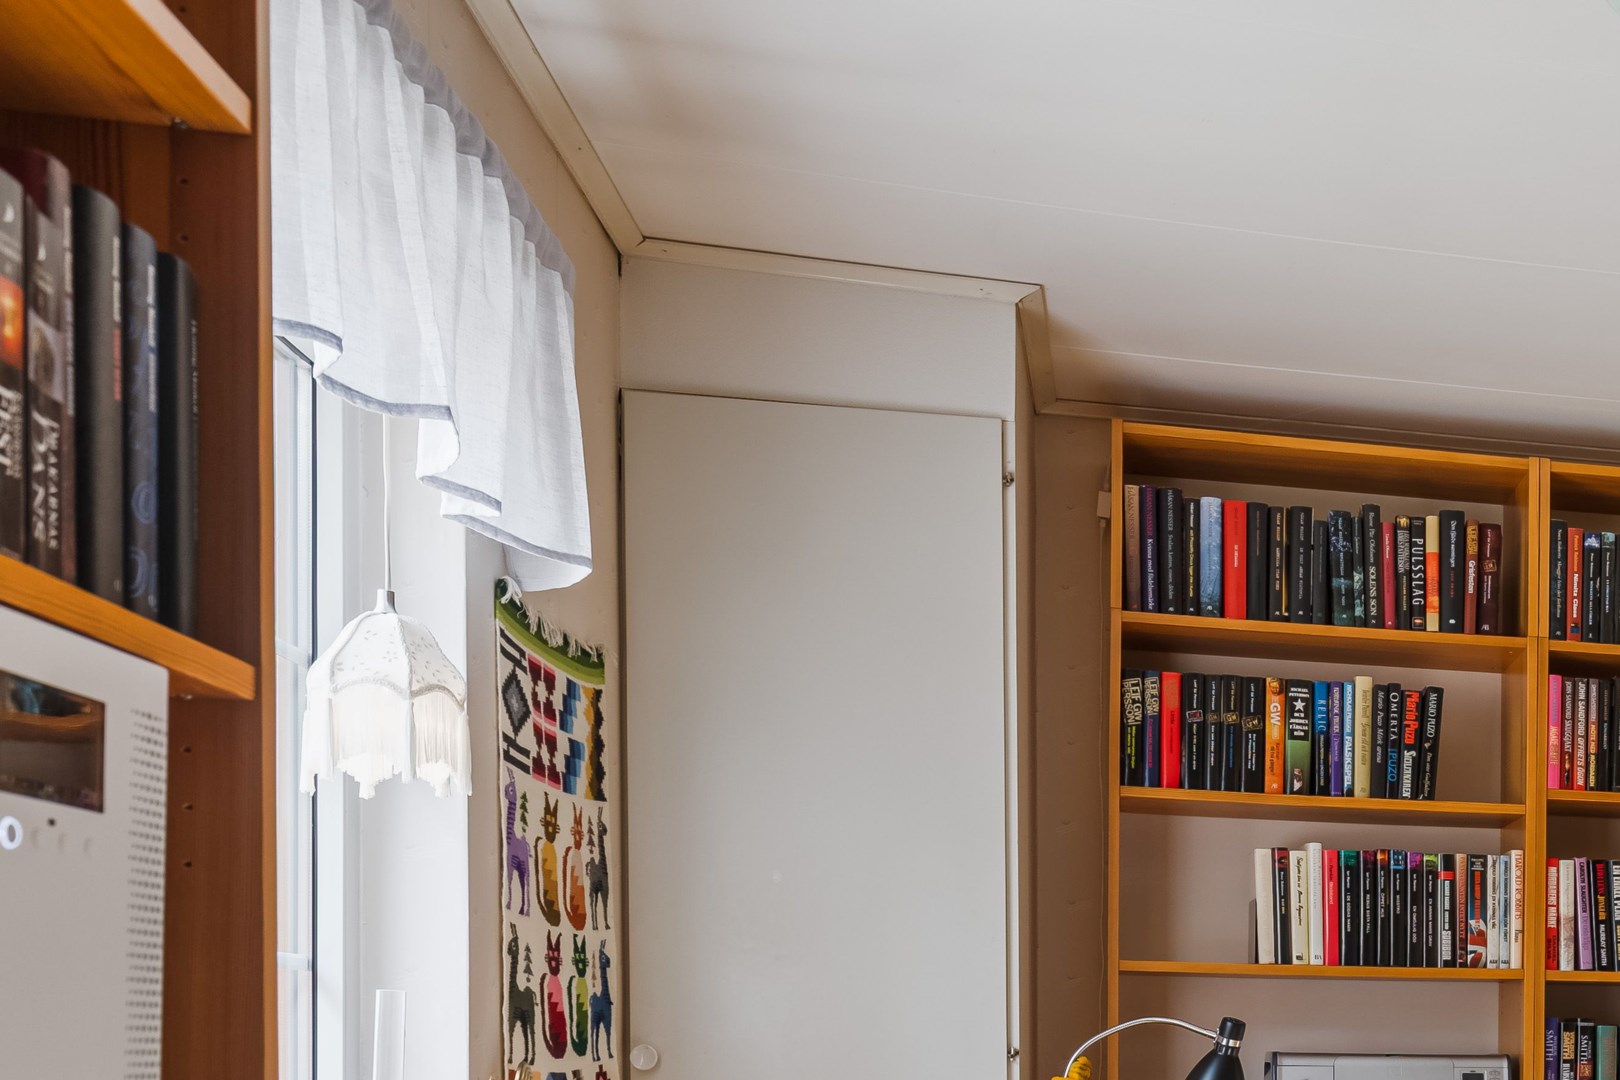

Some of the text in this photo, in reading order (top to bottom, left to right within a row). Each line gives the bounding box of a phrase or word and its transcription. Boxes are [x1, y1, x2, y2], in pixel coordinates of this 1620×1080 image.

[1411, 538, 1425, 606] PULSSLAG
[1369, 565, 1378, 617] SOLENS SON
[1578, 681, 1587, 700] JOHN
[1269, 702, 1282, 726] GW
[1577, 700, 1587, 736] SANDFORD
[1343, 735, 1353, 789] FALSKSPEL
[1387, 750, 1399, 782] PUZO
[1546, 1029, 1555, 1061] SMITH
[1580, 1034, 1590, 1065] SMITH
